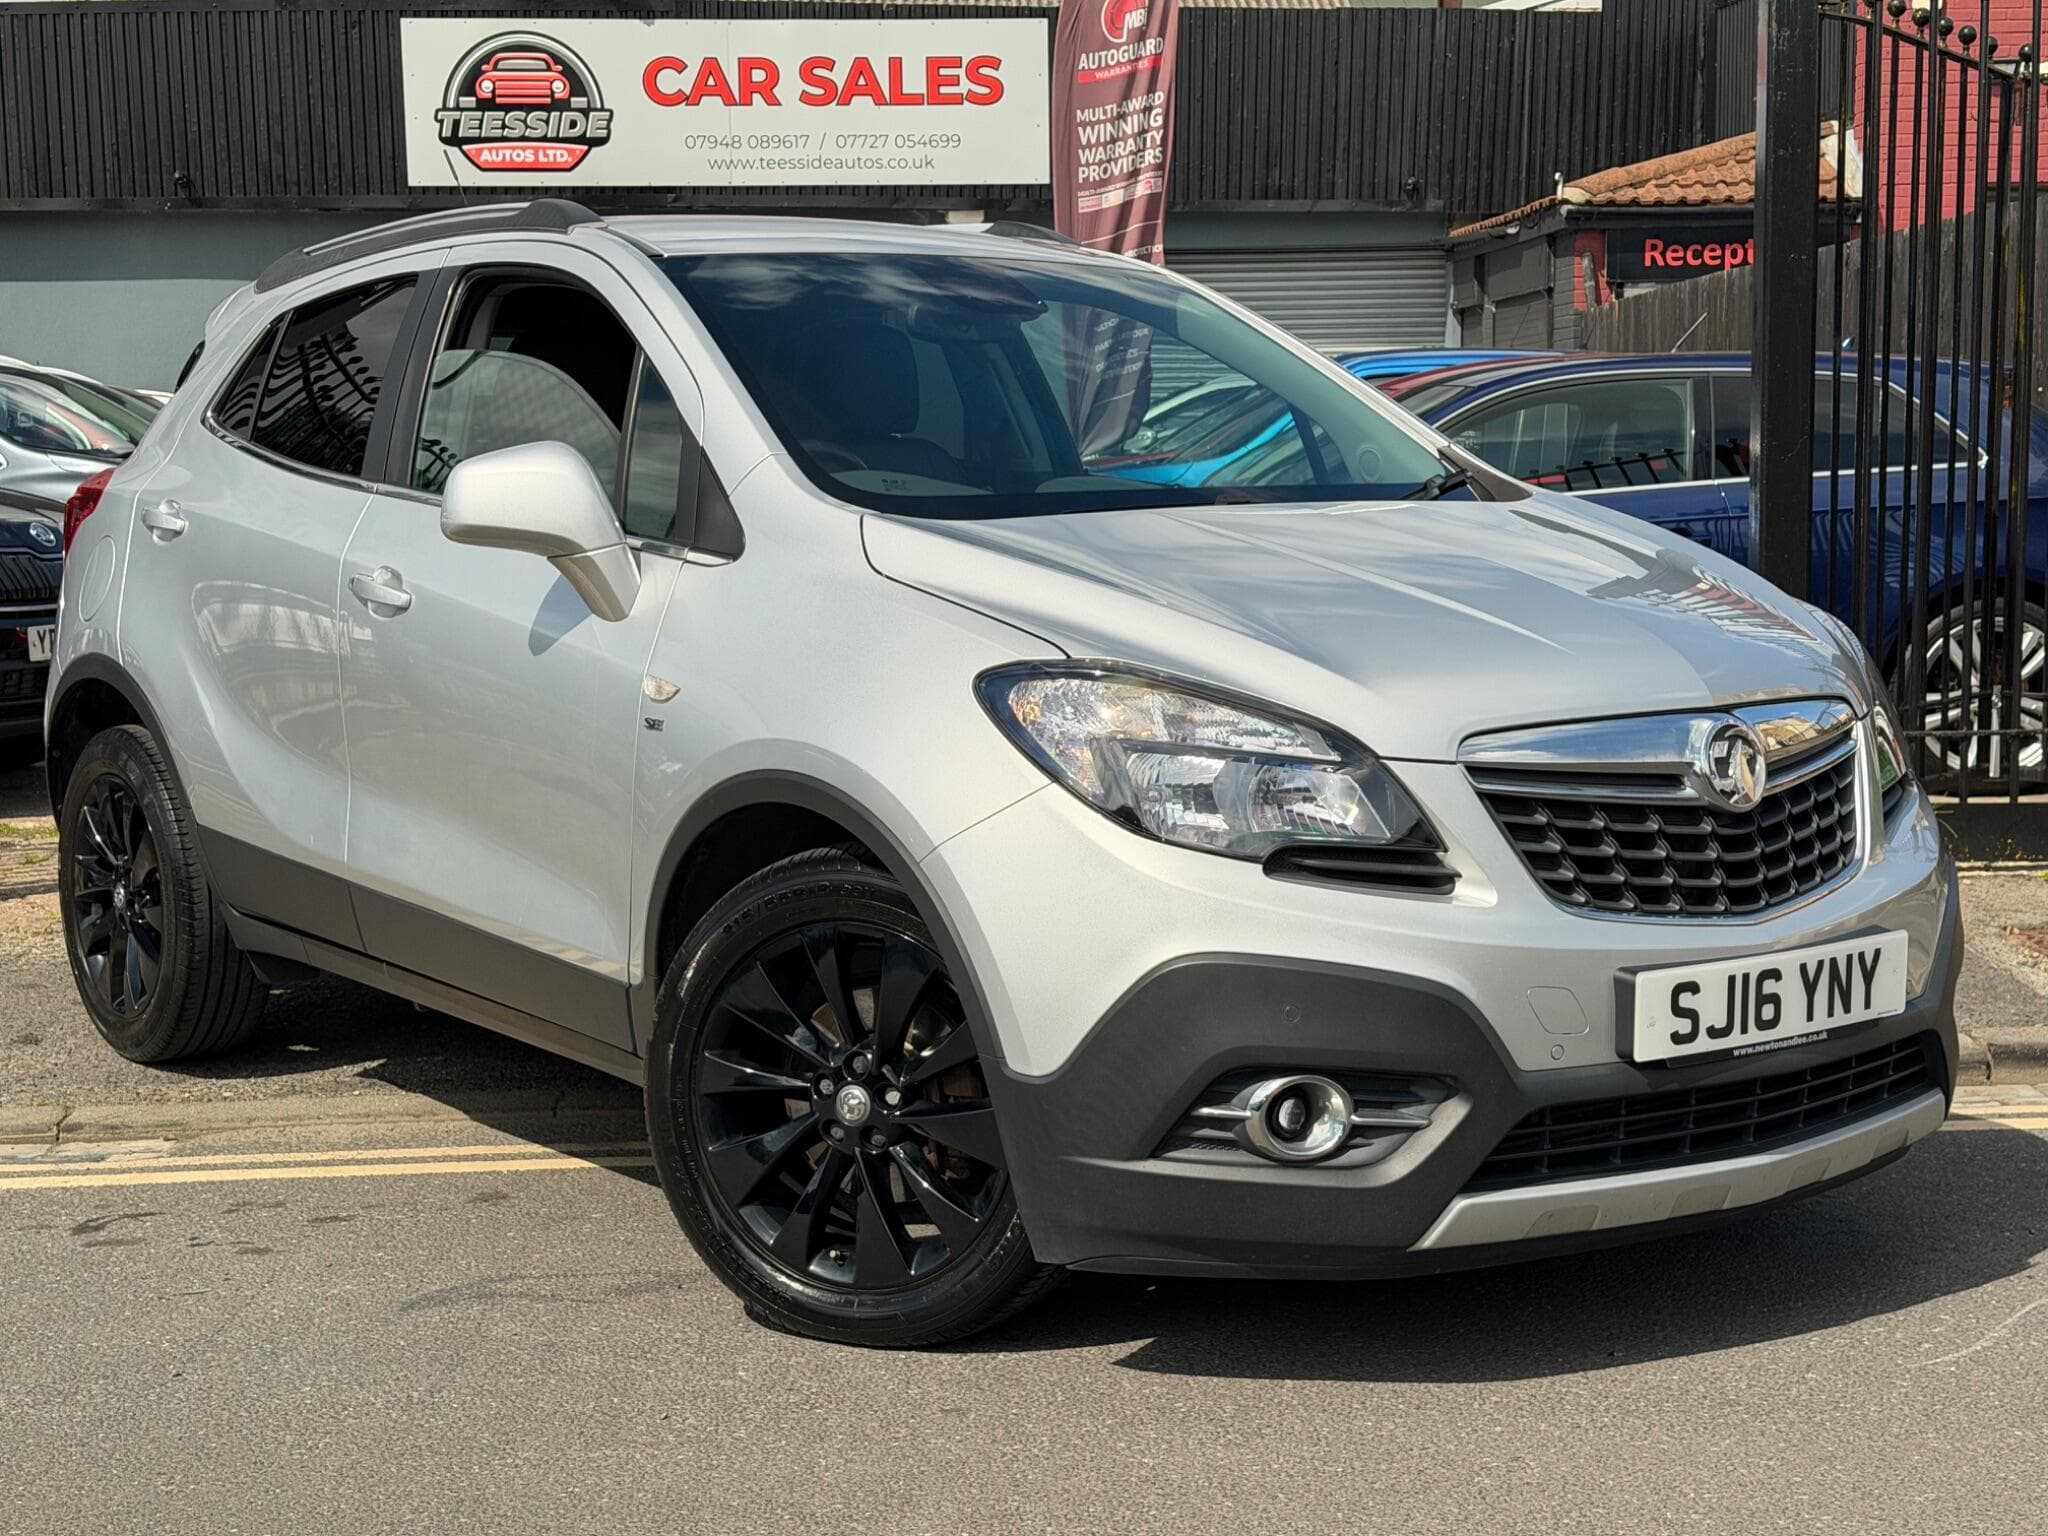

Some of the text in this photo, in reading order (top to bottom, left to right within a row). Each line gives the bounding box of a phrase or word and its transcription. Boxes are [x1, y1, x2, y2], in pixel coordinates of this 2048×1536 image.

[1078, 37, 1164, 70] AUTOGUARD
[642, 55, 1005, 107] CAR SALES
[1076, 91, 1164, 123] MULTI-AWARD
[437, 110, 612, 139] TEESSIDE
[1078, 108, 1163, 146] WINNING
[480, 149, 572, 162] AUTOS LTD.
[685, 132, 961, 150] 07948 089617 / 07727 054699
[1078, 129, 1164, 165] WARRANTY
[707, 155, 936, 170] www.teessideautos.co.uk
[1078, 147, 1164, 183] PROVIDERS
[1669, 948, 1881, 1046] SJ16 YNY
[1732, 1030, 1828, 1057] www.newtonandlee.co.uk
